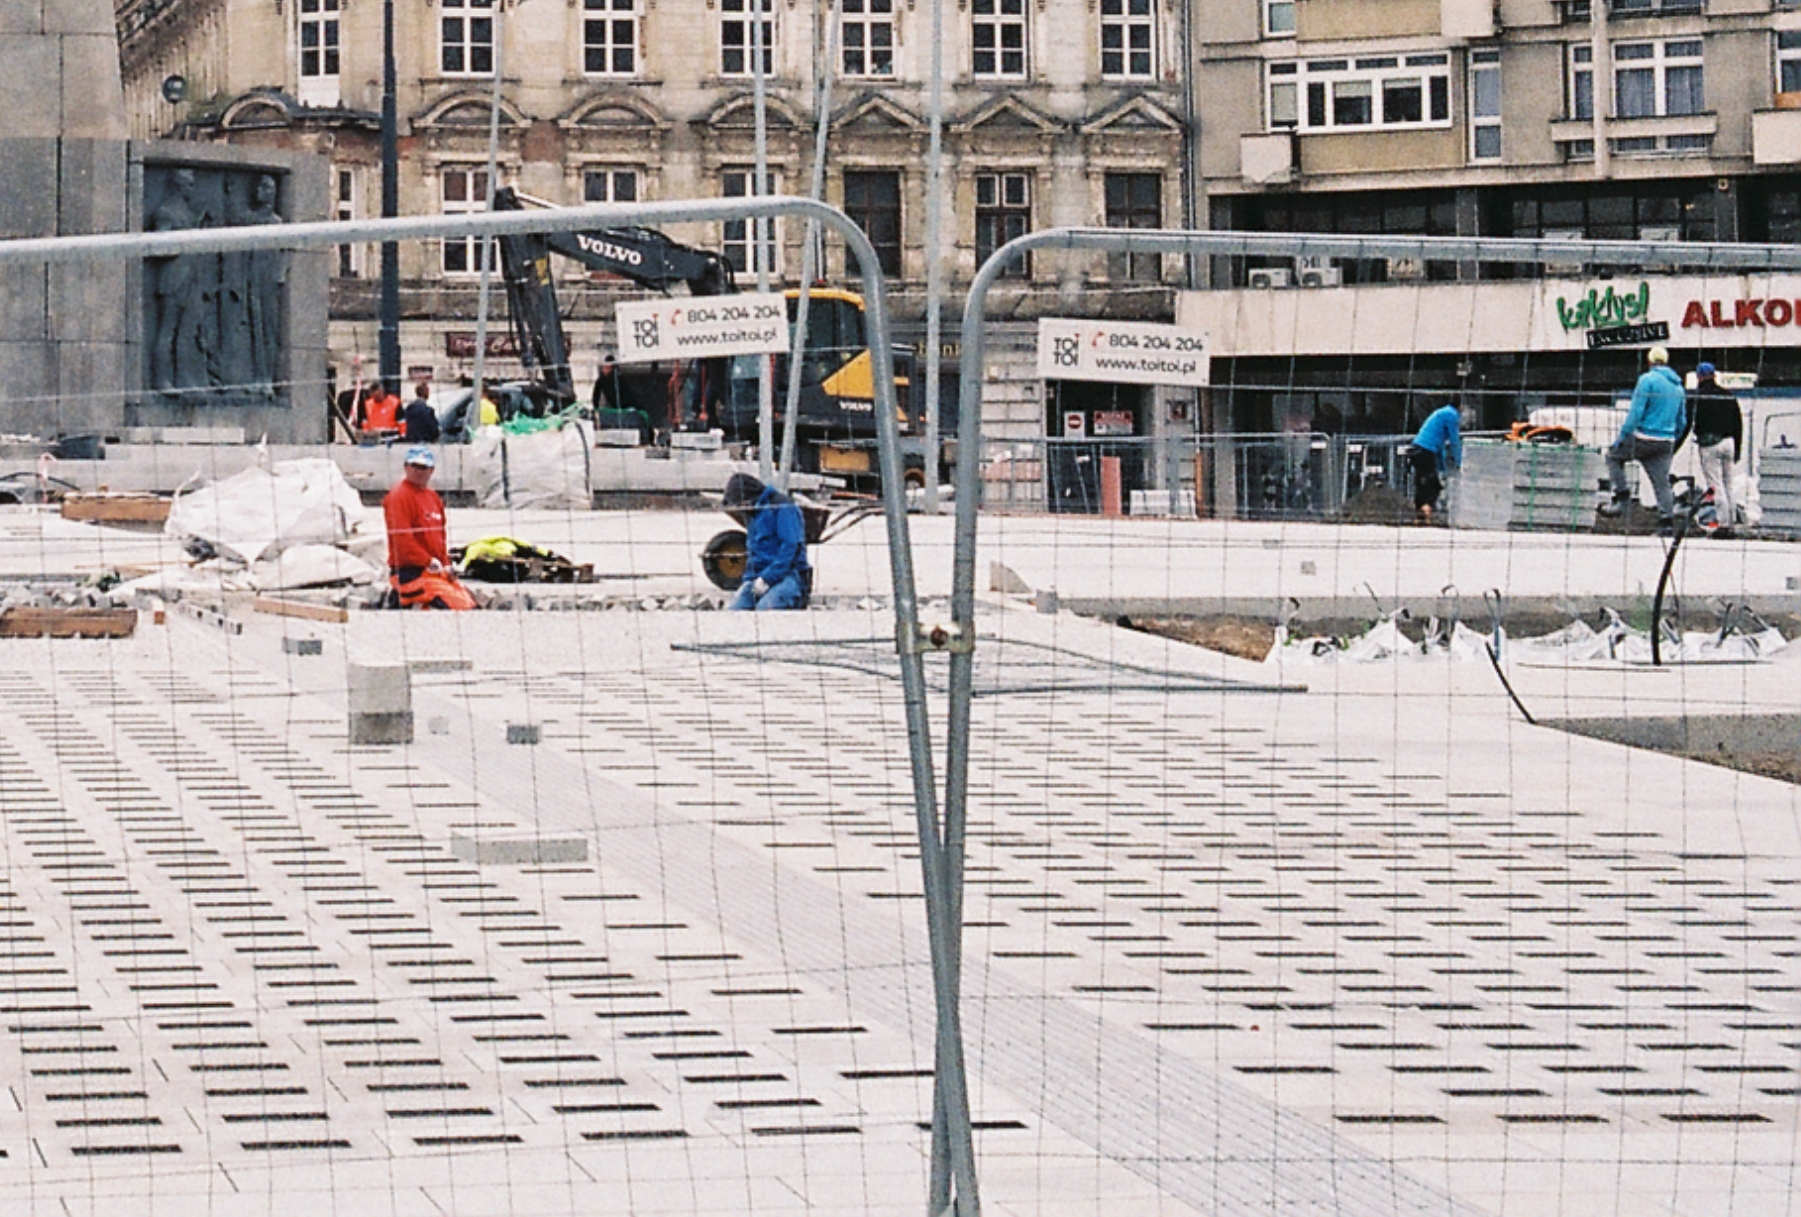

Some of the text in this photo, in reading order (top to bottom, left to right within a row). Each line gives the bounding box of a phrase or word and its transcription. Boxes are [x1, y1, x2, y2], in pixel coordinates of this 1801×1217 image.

[576, 234, 642, 265] VOLVO
[687, 305, 780, 323] 804 204 204
[1681, 299, 1801, 328] ALKO
[633, 315, 659, 333] TOI
[633, 334, 659, 348] TOI
[676, 327, 779, 346] www.toitoi.pl
[1053, 334, 1079, 351] TOI
[1108, 334, 1204, 352] 804 204 204
[1053, 351, 1079, 367] TOI
[1096, 358, 1197, 376] www.toitoi.pl
